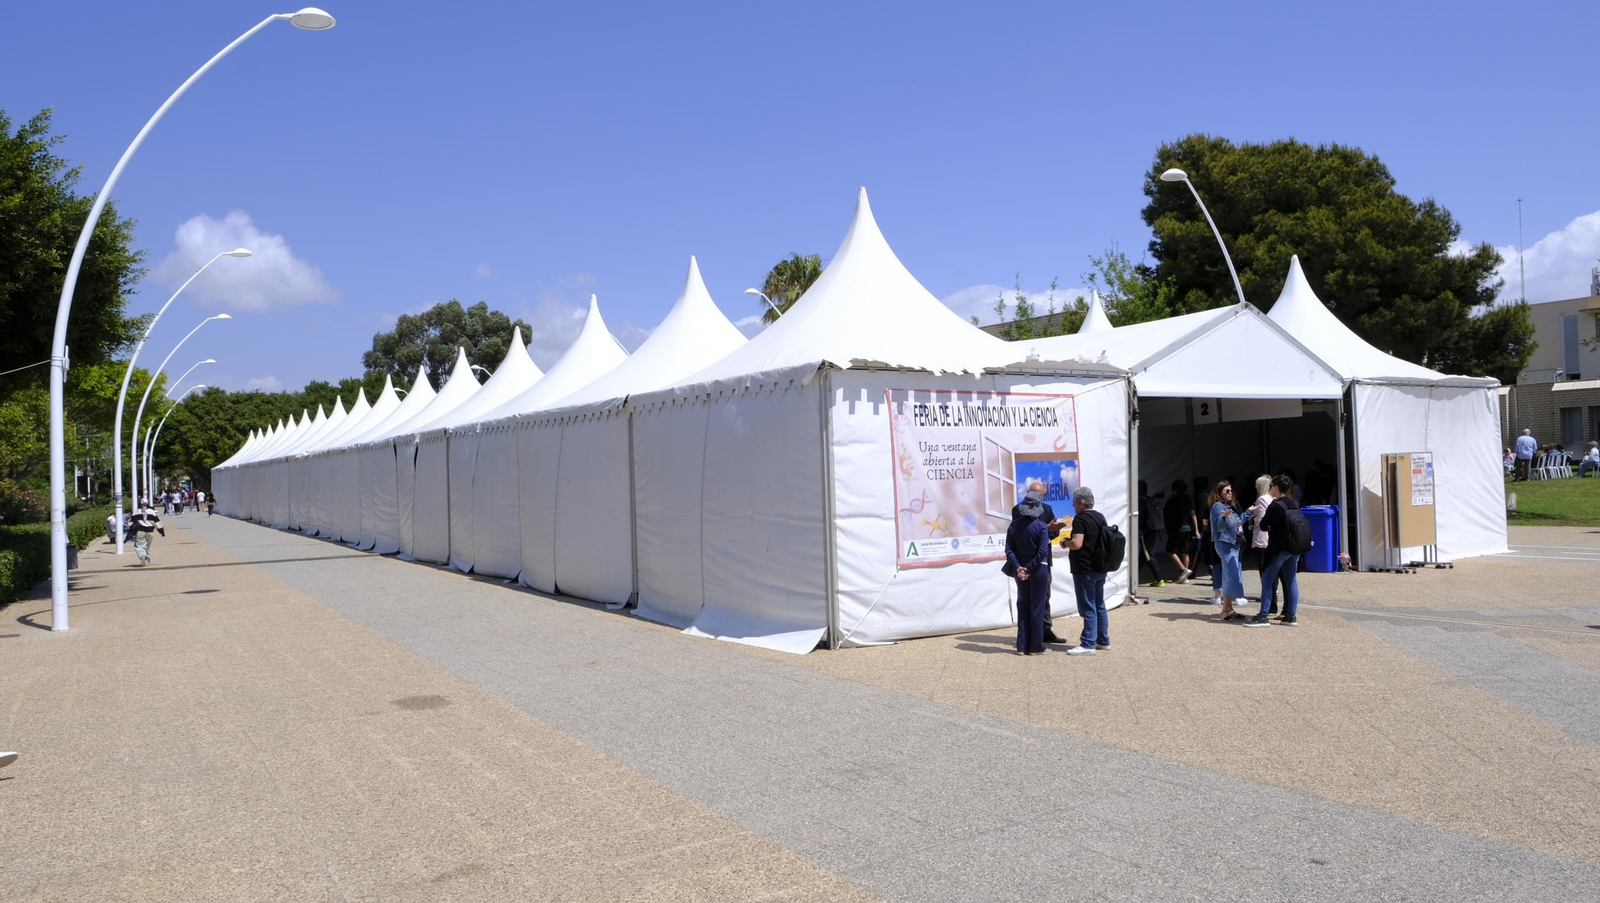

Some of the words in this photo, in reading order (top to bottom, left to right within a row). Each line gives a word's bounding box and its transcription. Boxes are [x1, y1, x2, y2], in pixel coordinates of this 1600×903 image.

[913, 404, 939, 427] FERIA
[939, 404, 951, 427] DE
[951, 405, 964, 427] LA
[963, 400, 1011, 428] INNOVACIÓN
[1010, 406, 1017, 428] Y
[1019, 406, 1029, 428] LA
[1029, 407, 1059, 428] CIENCIA
[1200, 402, 1209, 416] 2
[919, 441, 939, 453] Una
[941, 442, 977, 453] ventana
[922, 452, 956, 466] abierta
[958, 457, 964, 466] a
[967, 452, 975, 465] la
[926, 468, 975, 481] CIENCIA
[1043, 478, 1070, 501] MERÍA
